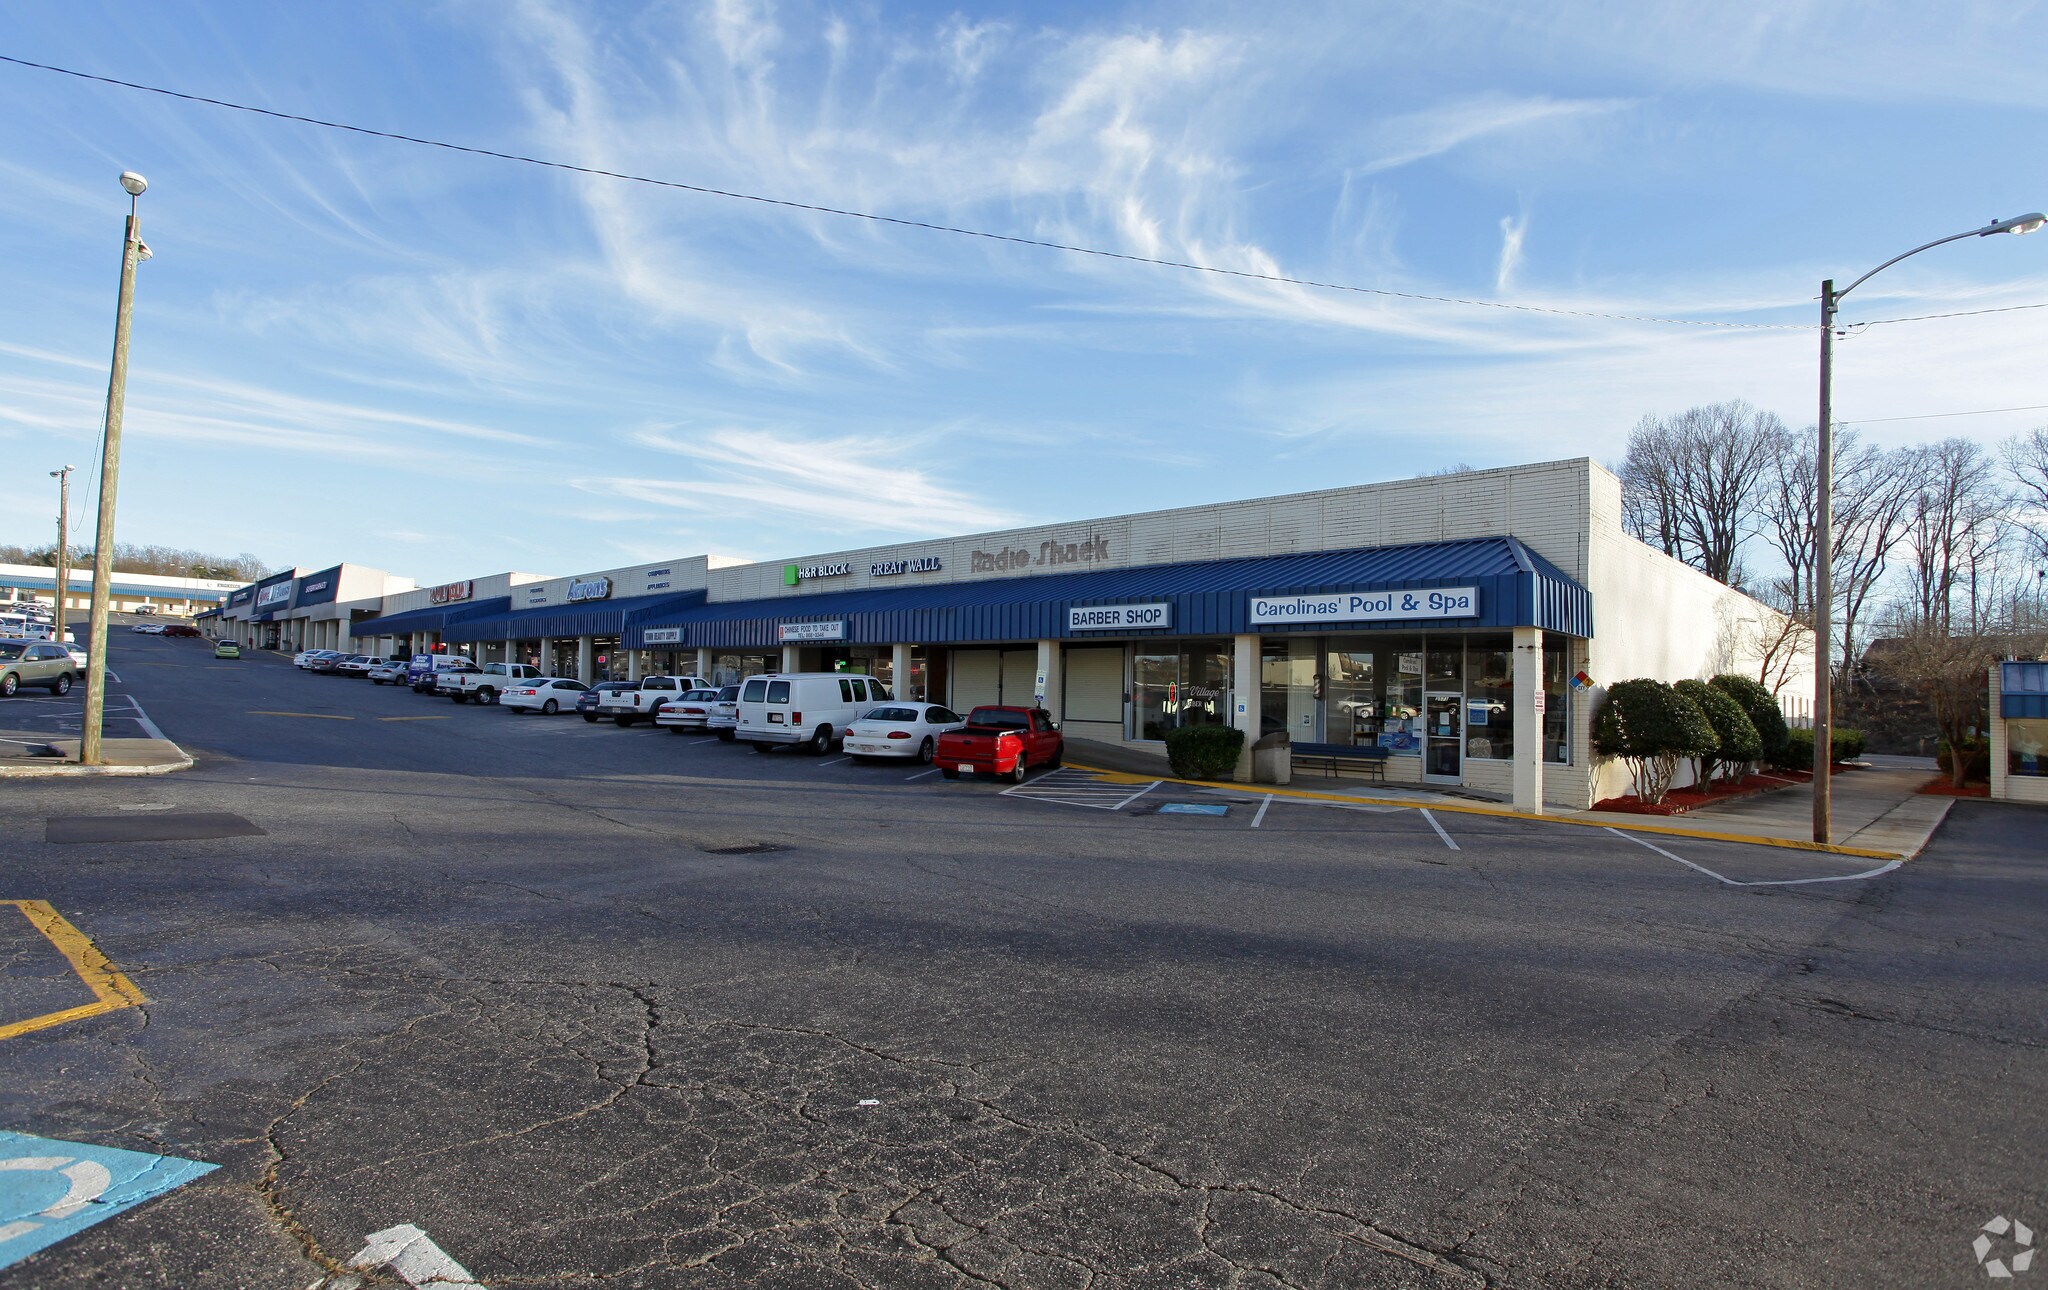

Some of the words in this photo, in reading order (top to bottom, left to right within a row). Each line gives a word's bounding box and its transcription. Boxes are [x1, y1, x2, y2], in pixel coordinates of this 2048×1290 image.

[970, 546, 1030, 573] Radio
[1036, 535, 1109, 566] Shack
[798, 568, 817, 578] H&R
[818, 563, 848, 577] BLOCK
[869, 561, 904, 576] GREAT
[907, 557, 940, 573] WALL
[566, 577, 608, 601] Aaron's
[1256, 598, 1342, 616] Carolinas'
[1350, 594, 1392, 613] Pool
[1401, 593, 1420, 611] &
[1428, 592, 1470, 614] Spa
[1072, 611, 1120, 625] BARBER
[1126, 609, 1162, 624] SHOP
[785, 625, 800, 633] CHINESE
[812, 624, 819, 632] TO
[820, 624, 829, 632] TAKE
[830, 623, 839, 631] OUT
[1189, 685, 1220, 701] Village
